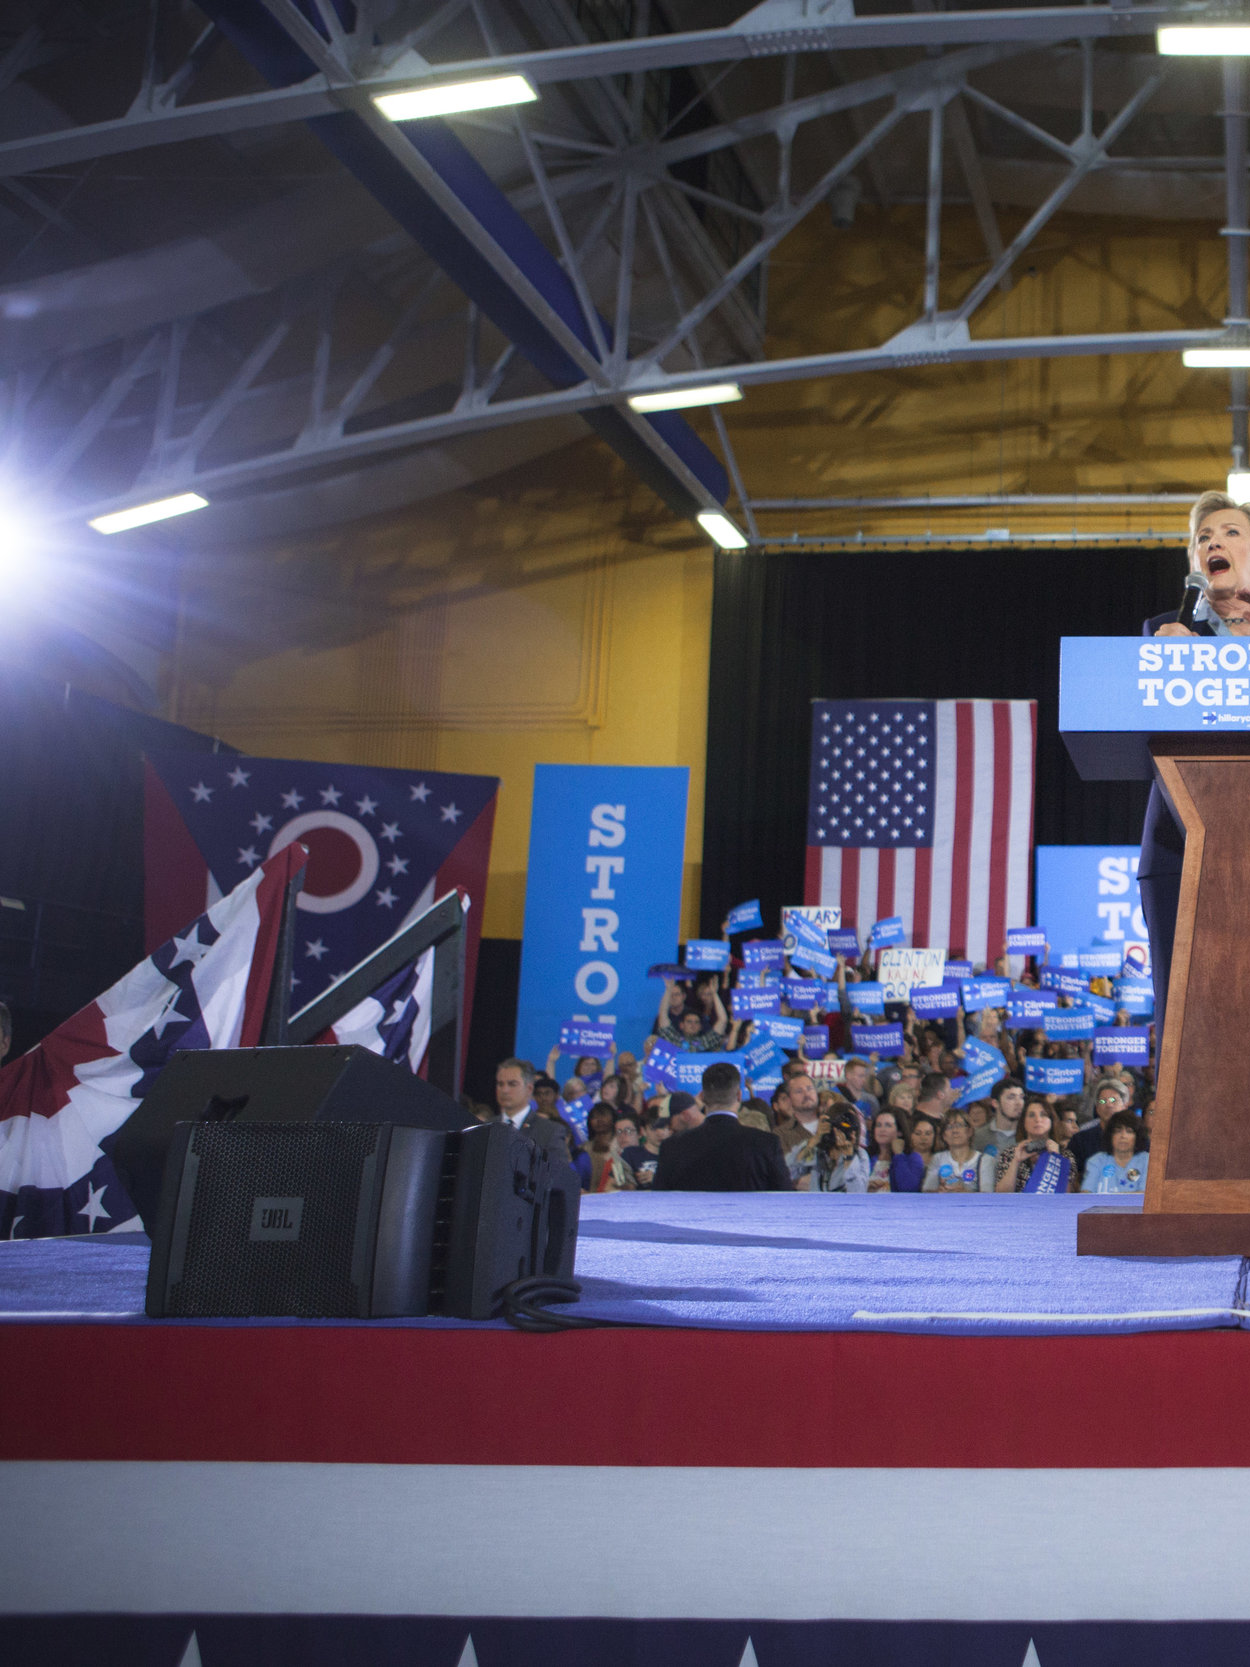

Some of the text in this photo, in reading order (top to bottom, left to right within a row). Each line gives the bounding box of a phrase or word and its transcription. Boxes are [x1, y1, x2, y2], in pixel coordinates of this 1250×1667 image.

[572, 804, 626, 1024] STRO
[750, 994, 778, 1002] Clinton
[912, 993, 957, 1002] STRONGER
[1024, 1000, 1056, 1009] Clinton
[1044, 1015, 1093, 1024] STRONGER
[1045, 1022, 1094, 1031] TOGETHER
[580, 1030, 613, 1040] Clinton
[855, 1032, 901, 1041] STRONGER
[580, 1039, 606, 1047] Kaine
[1096, 1036, 1146, 1045] STRONGER
[1096, 1045, 1146, 1053] TOGETHER
[1047, 1068, 1081, 1077] Clinton
[1047, 1076, 1075, 1084] Kaine
[261, 1208, 293, 1229] JBL
